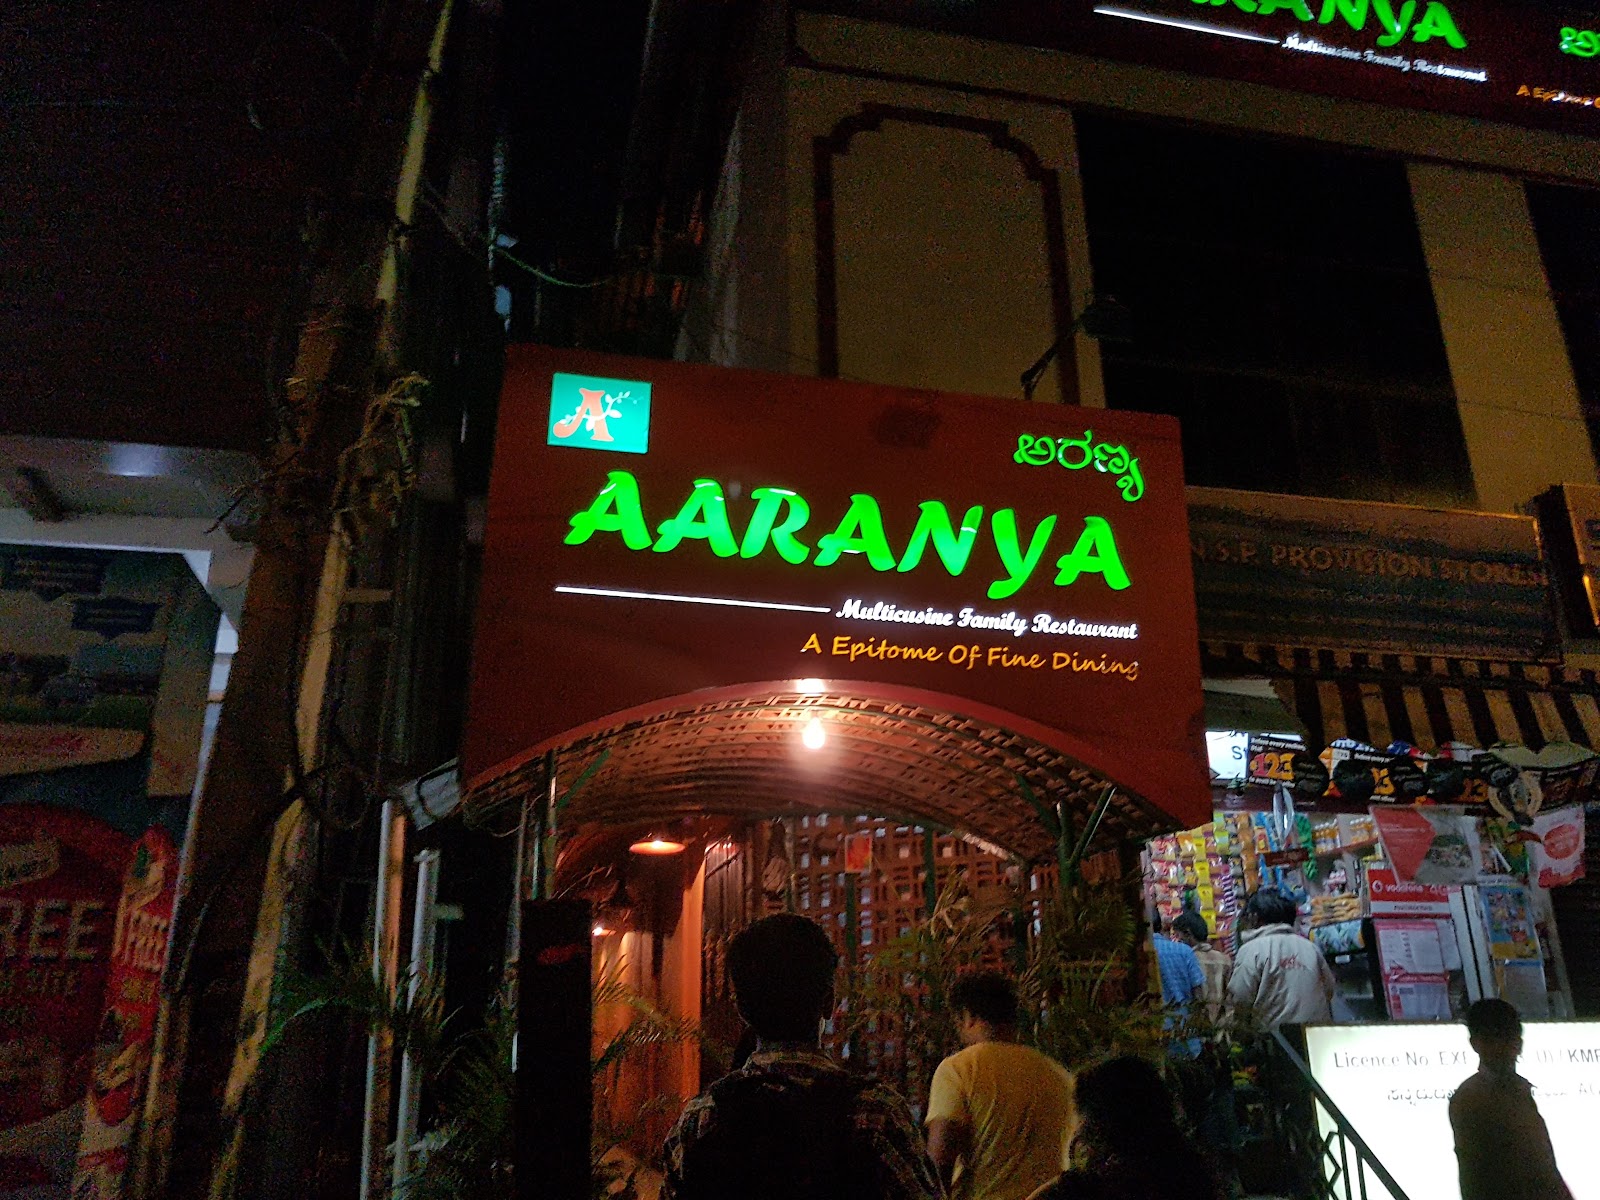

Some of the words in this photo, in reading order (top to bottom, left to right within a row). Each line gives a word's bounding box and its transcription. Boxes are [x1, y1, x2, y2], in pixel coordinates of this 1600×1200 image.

[563, 470, 1132, 600] AARANYA
[1270, 543, 1432, 579] PROVISION
[836, 598, 954, 627] Multicusine
[957, 607, 1029, 637] Family
[1031, 613, 1139, 640] Restaurant
[800, 633, 823, 653] A
[831, 635, 943, 662] Epitome
[949, 644, 982, 670] Of
[986, 646, 1046, 670] Fine
[1052, 651, 1140, 682] Dining
[1333, 1051, 1400, 1068] Licence
[1406, 1051, 1429, 1066] No
